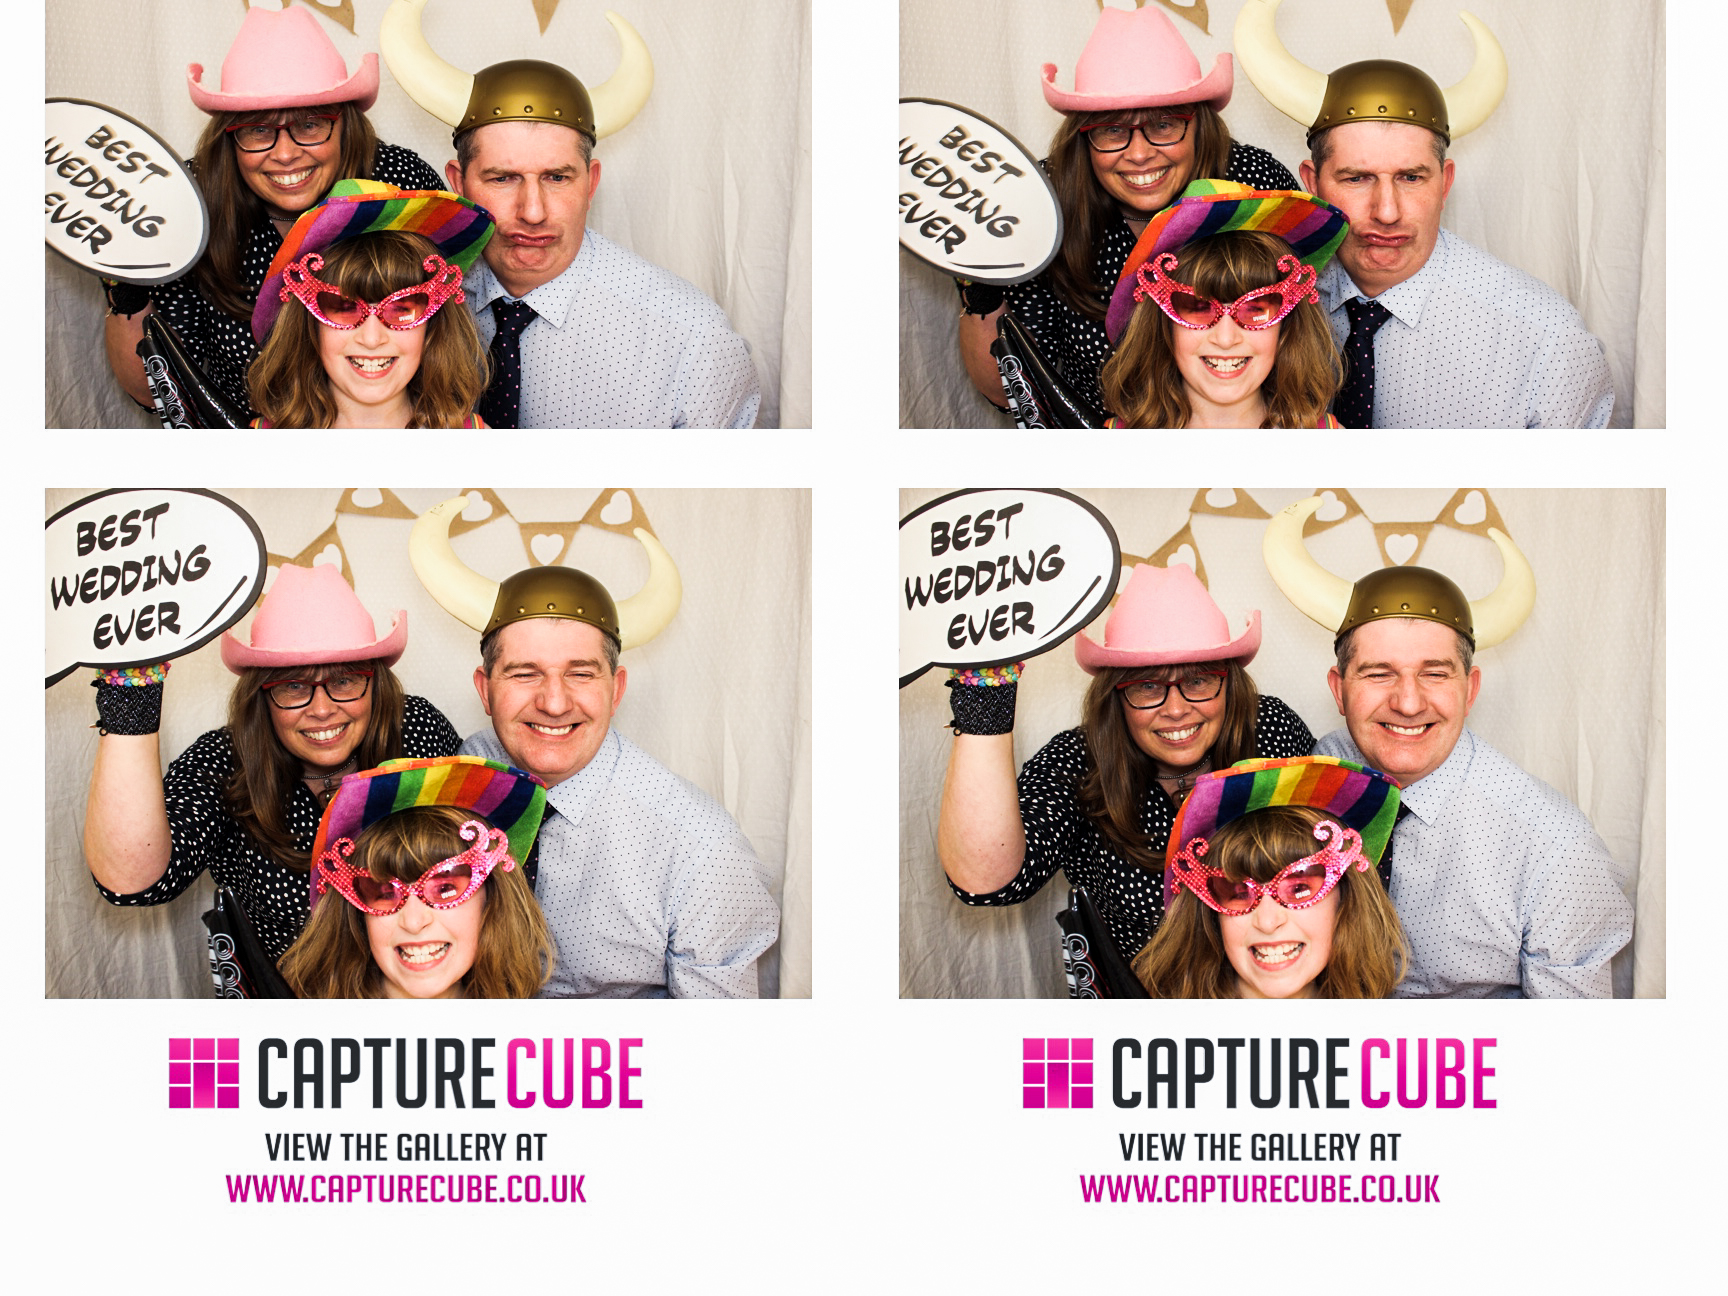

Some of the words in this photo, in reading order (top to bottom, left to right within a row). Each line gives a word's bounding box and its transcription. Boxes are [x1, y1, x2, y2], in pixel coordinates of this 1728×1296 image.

[85, 124, 173, 184] BEST
[939, 124, 1027, 184] BEST
[45, 135, 167, 238] WEDDING
[899, 135, 1021, 238] WEDDING
[76, 502, 170, 557] BEST
[930, 502, 1024, 557] BEST
[51, 544, 212, 611] WEDDING
[905, 544, 1066, 611] WEDDING
[93, 601, 181, 650] EVER
[947, 601, 1035, 650] EVER
